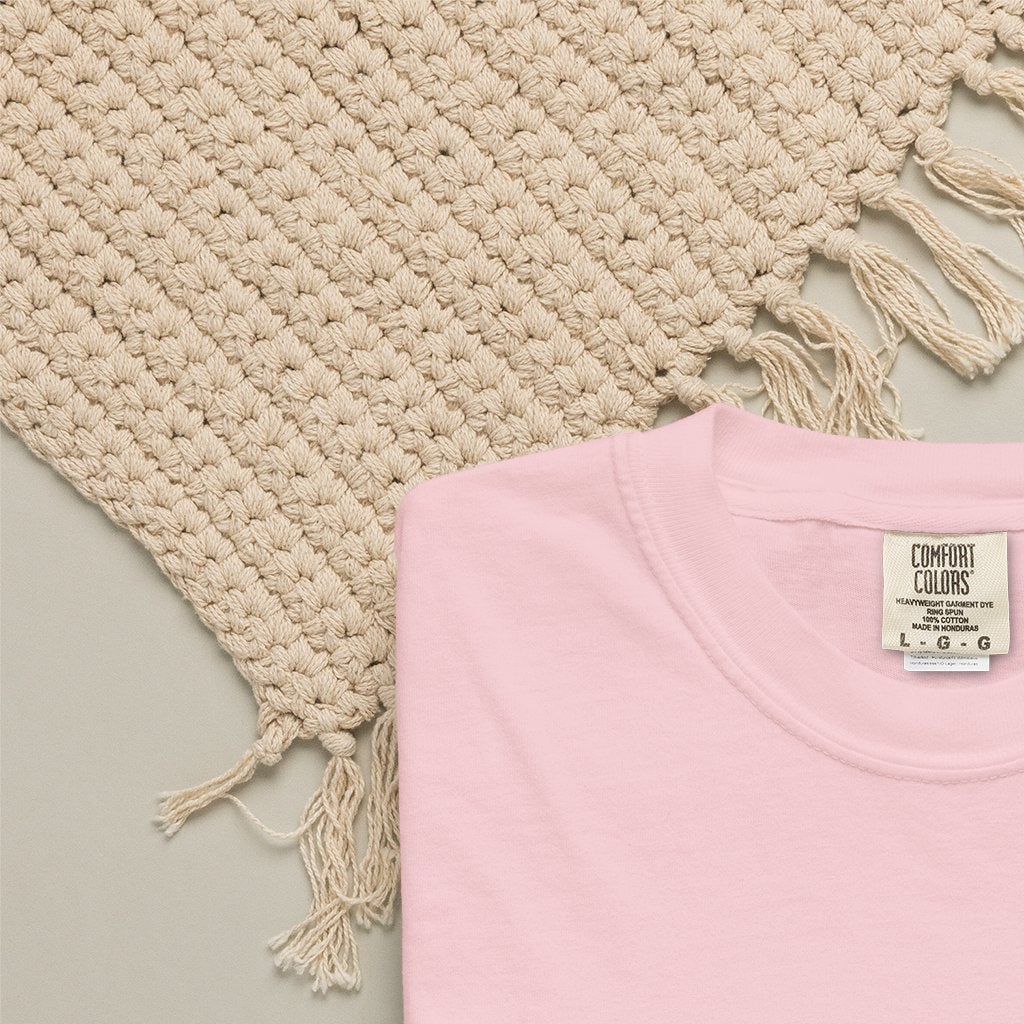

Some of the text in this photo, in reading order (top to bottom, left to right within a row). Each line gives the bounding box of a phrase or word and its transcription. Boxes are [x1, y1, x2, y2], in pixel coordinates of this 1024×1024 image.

[911, 543, 975, 568] COMFORT
[896, 598, 944, 608] HEAVYWEIGHT
[945, 600, 979, 608] GARMENT
[926, 608, 943, 616] RING
[912, 623, 932, 631] MADE
[941, 624, 979, 632] HONDURAS
[900, 632, 911, 647] L
[937, 635, 951, 650] G
[977, 636, 991, 651] G
